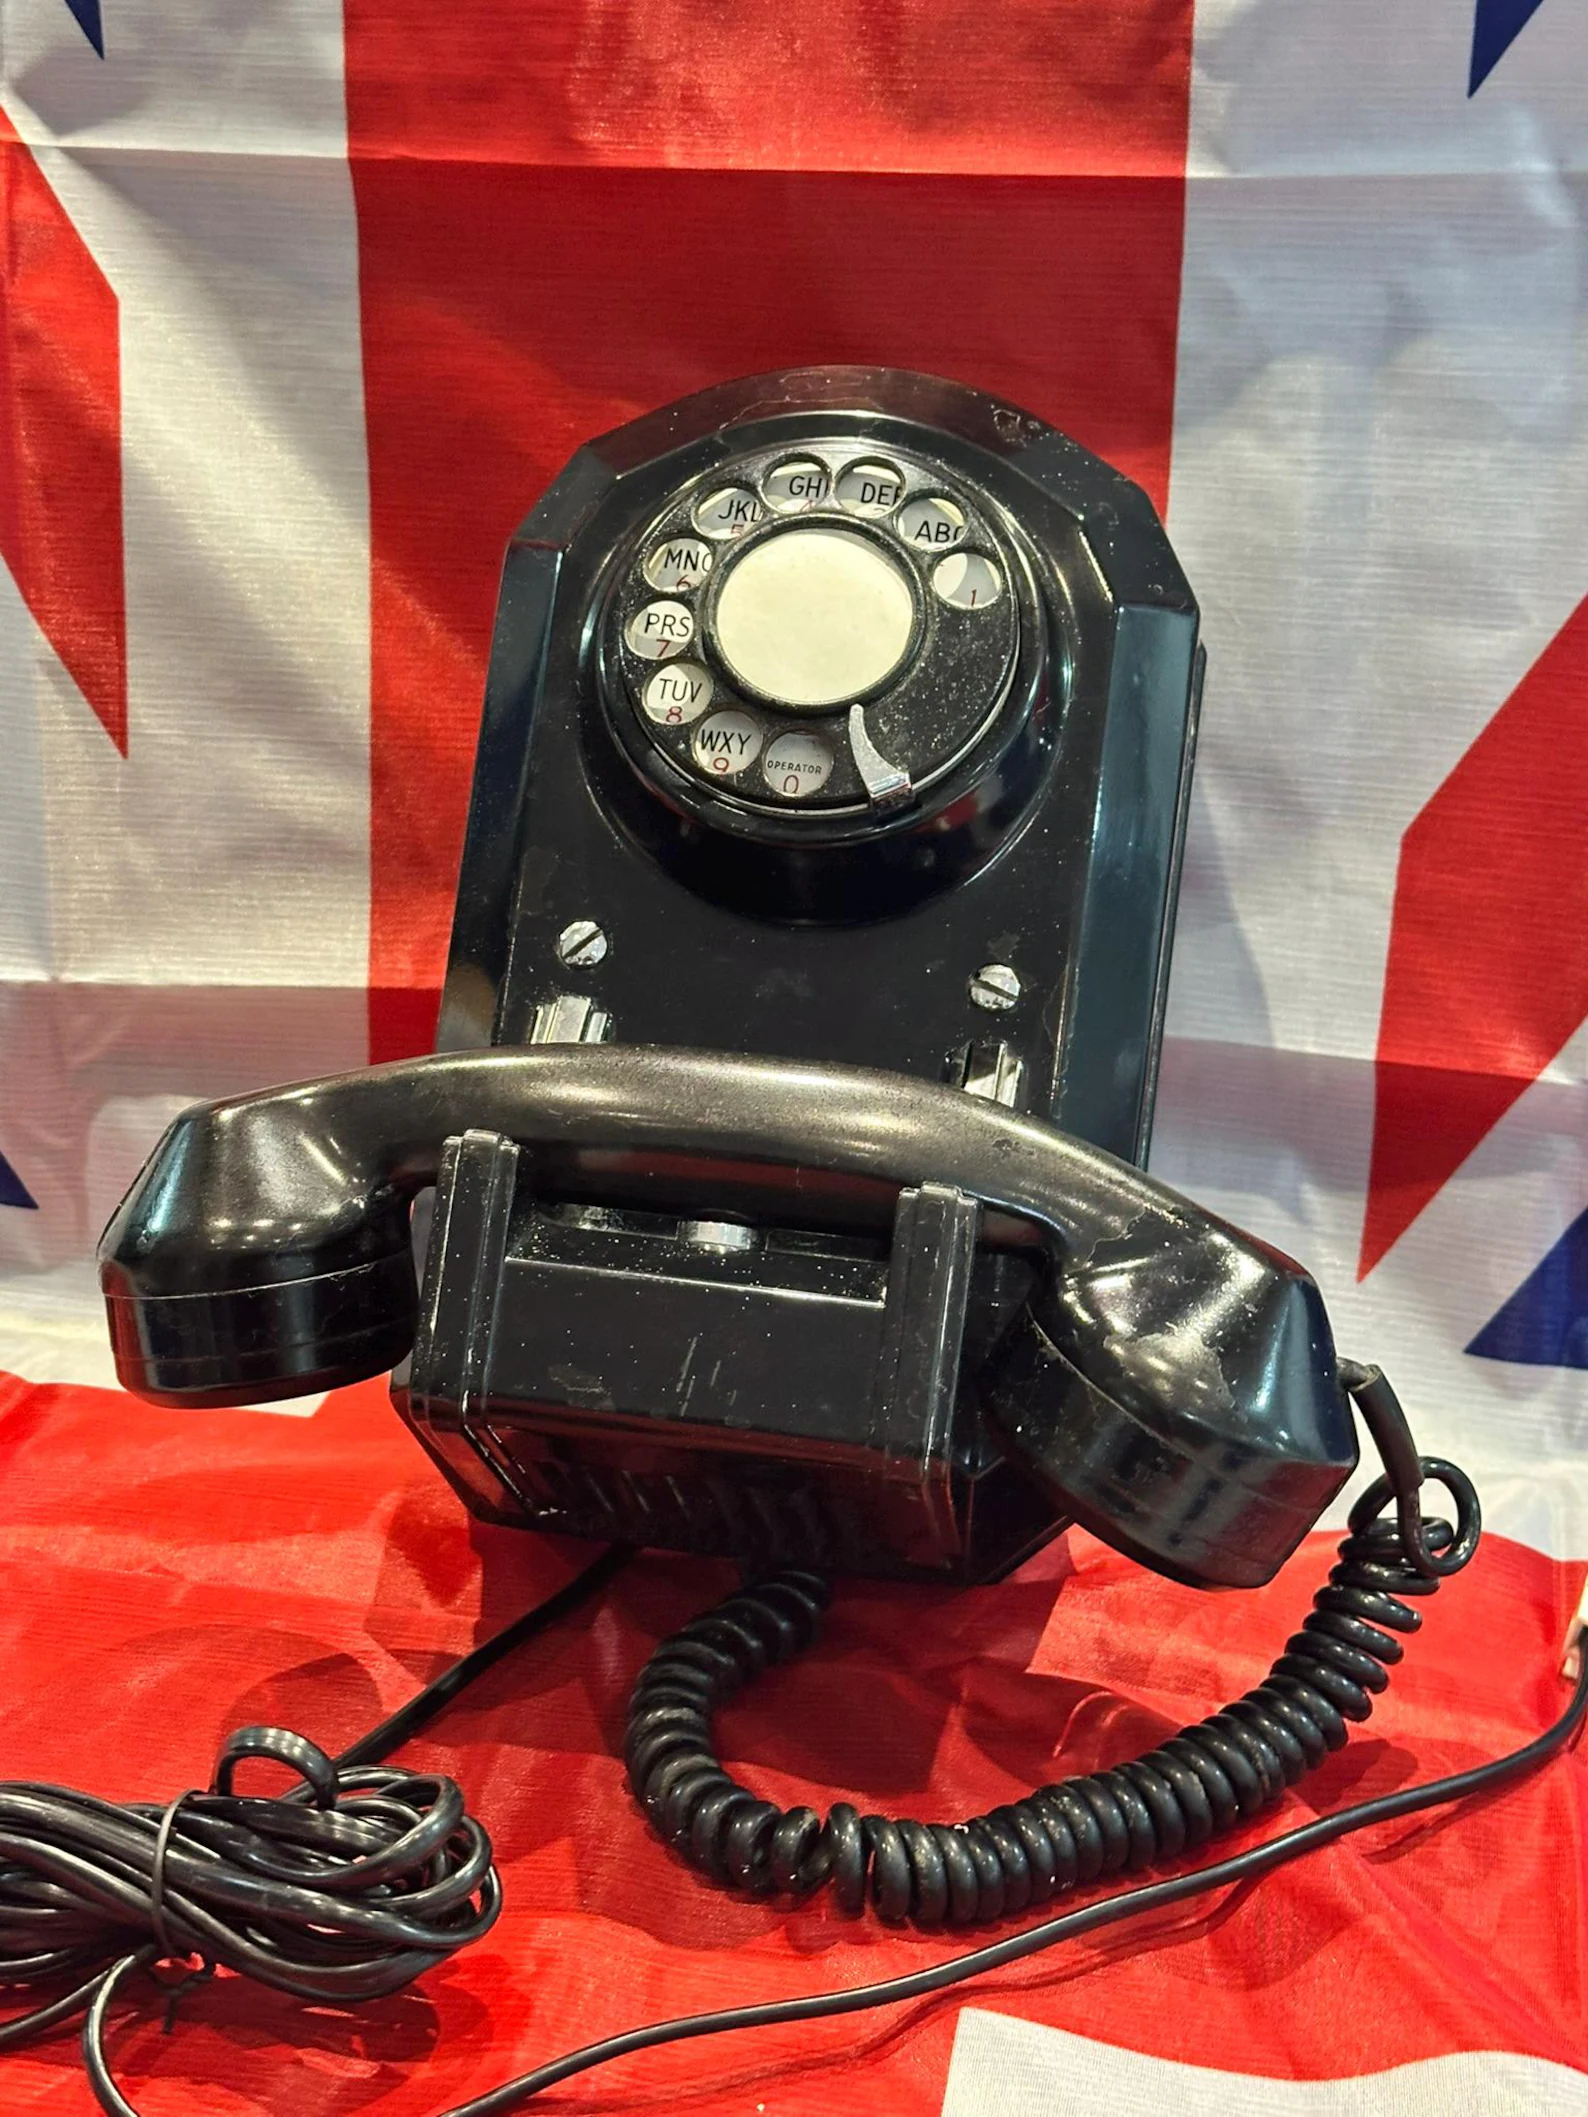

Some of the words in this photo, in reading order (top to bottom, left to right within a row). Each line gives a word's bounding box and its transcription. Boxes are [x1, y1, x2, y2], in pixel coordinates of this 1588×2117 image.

[970, 589, 978, 607] 1
[644, 612, 691, 637] PRS
[656, 638, 672, 657] 7
[659, 677, 703, 704] TUV
[666, 705, 683, 722] 8
[701, 728, 752, 755] WXY
[713, 757, 729, 778] 9
[767, 760, 822, 774] OPERATOR
